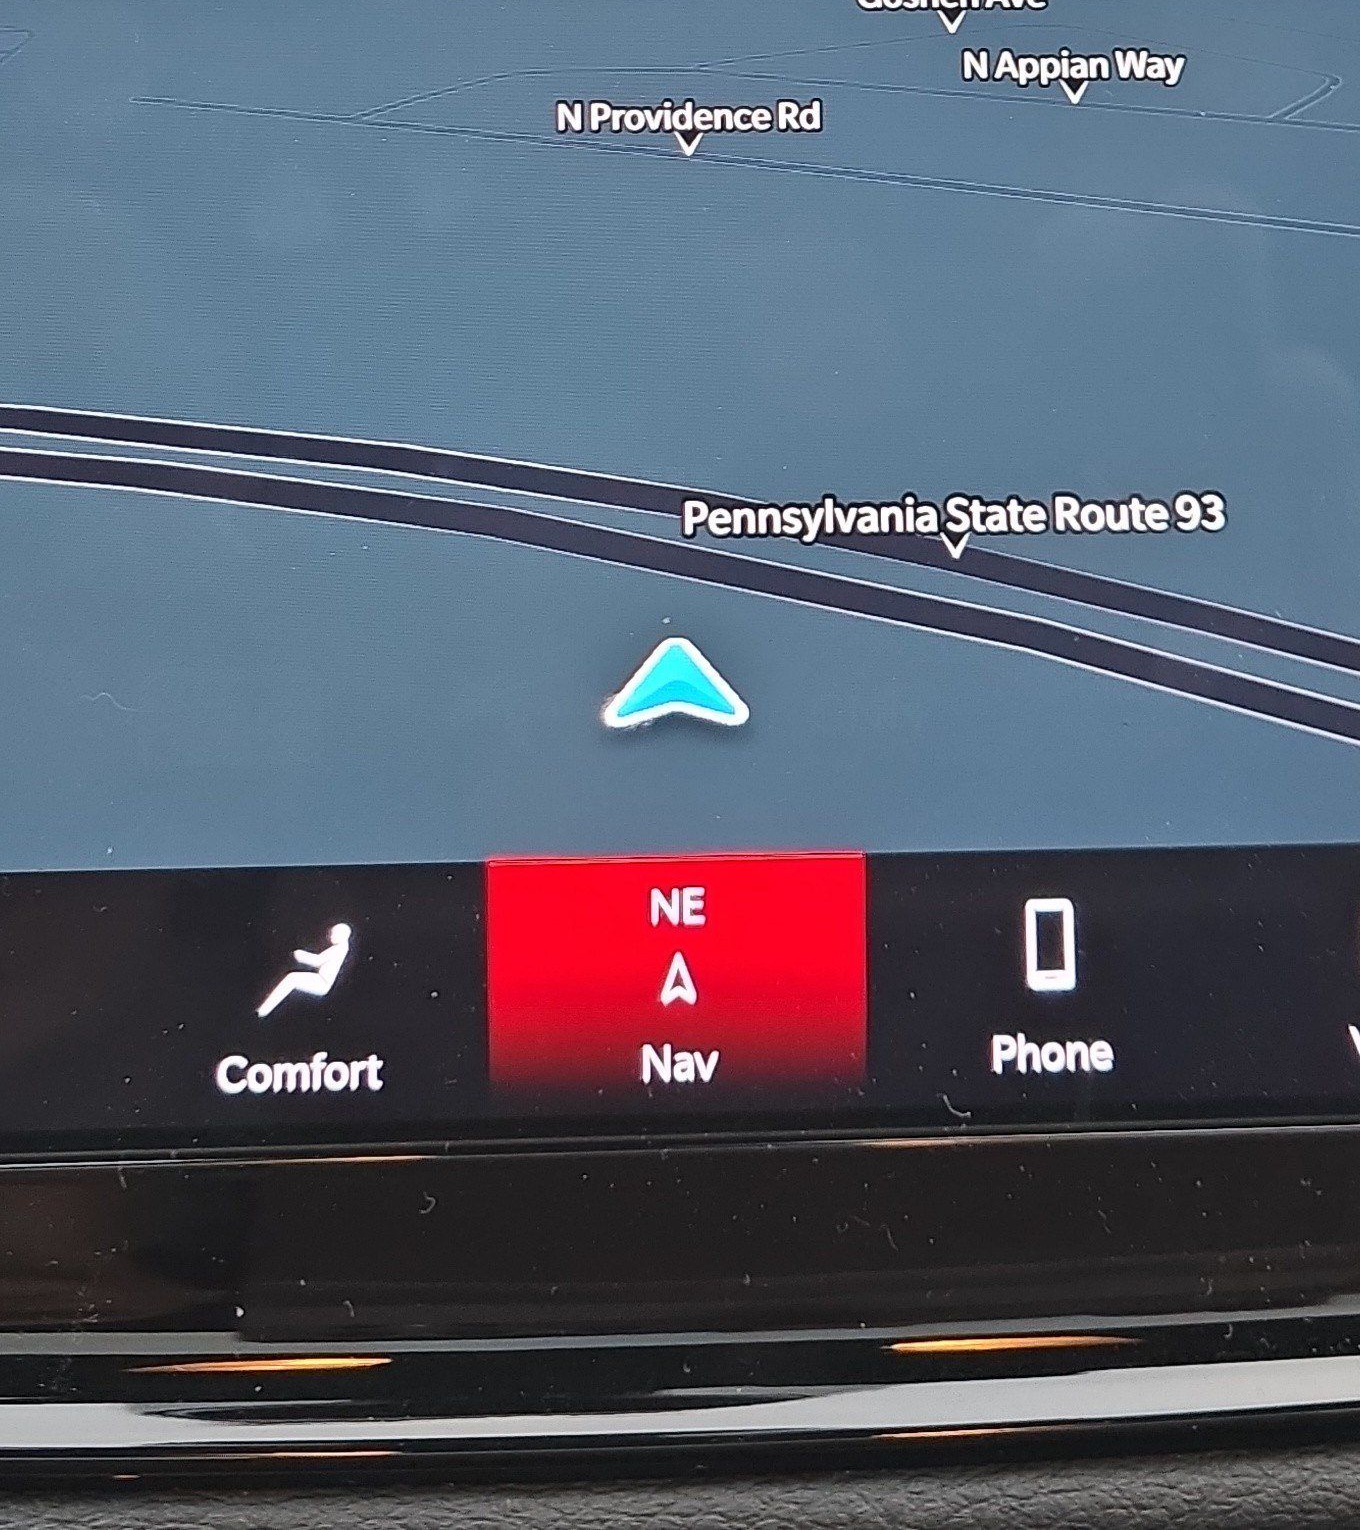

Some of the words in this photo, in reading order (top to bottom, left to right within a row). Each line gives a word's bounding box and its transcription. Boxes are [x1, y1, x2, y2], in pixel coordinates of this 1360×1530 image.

[964, 52, 991, 80] N
[993, 51, 1111, 87] Appian
[1115, 51, 1185, 86] Way
[557, 104, 584, 131] N
[590, 102, 776, 132] Providence
[778, 103, 822, 132] Rd
[684, 496, 939, 542] Pennsylvania
[946, 498, 1047, 533] State
[1054, 498, 1169, 532] Route
[1175, 495, 1224, 532] 93
[650, 888, 705, 927] NE
[216, 1054, 383, 1095] Comfort
[640, 1043, 718, 1084] Nav
[990, 1034, 1114, 1075] Phone
